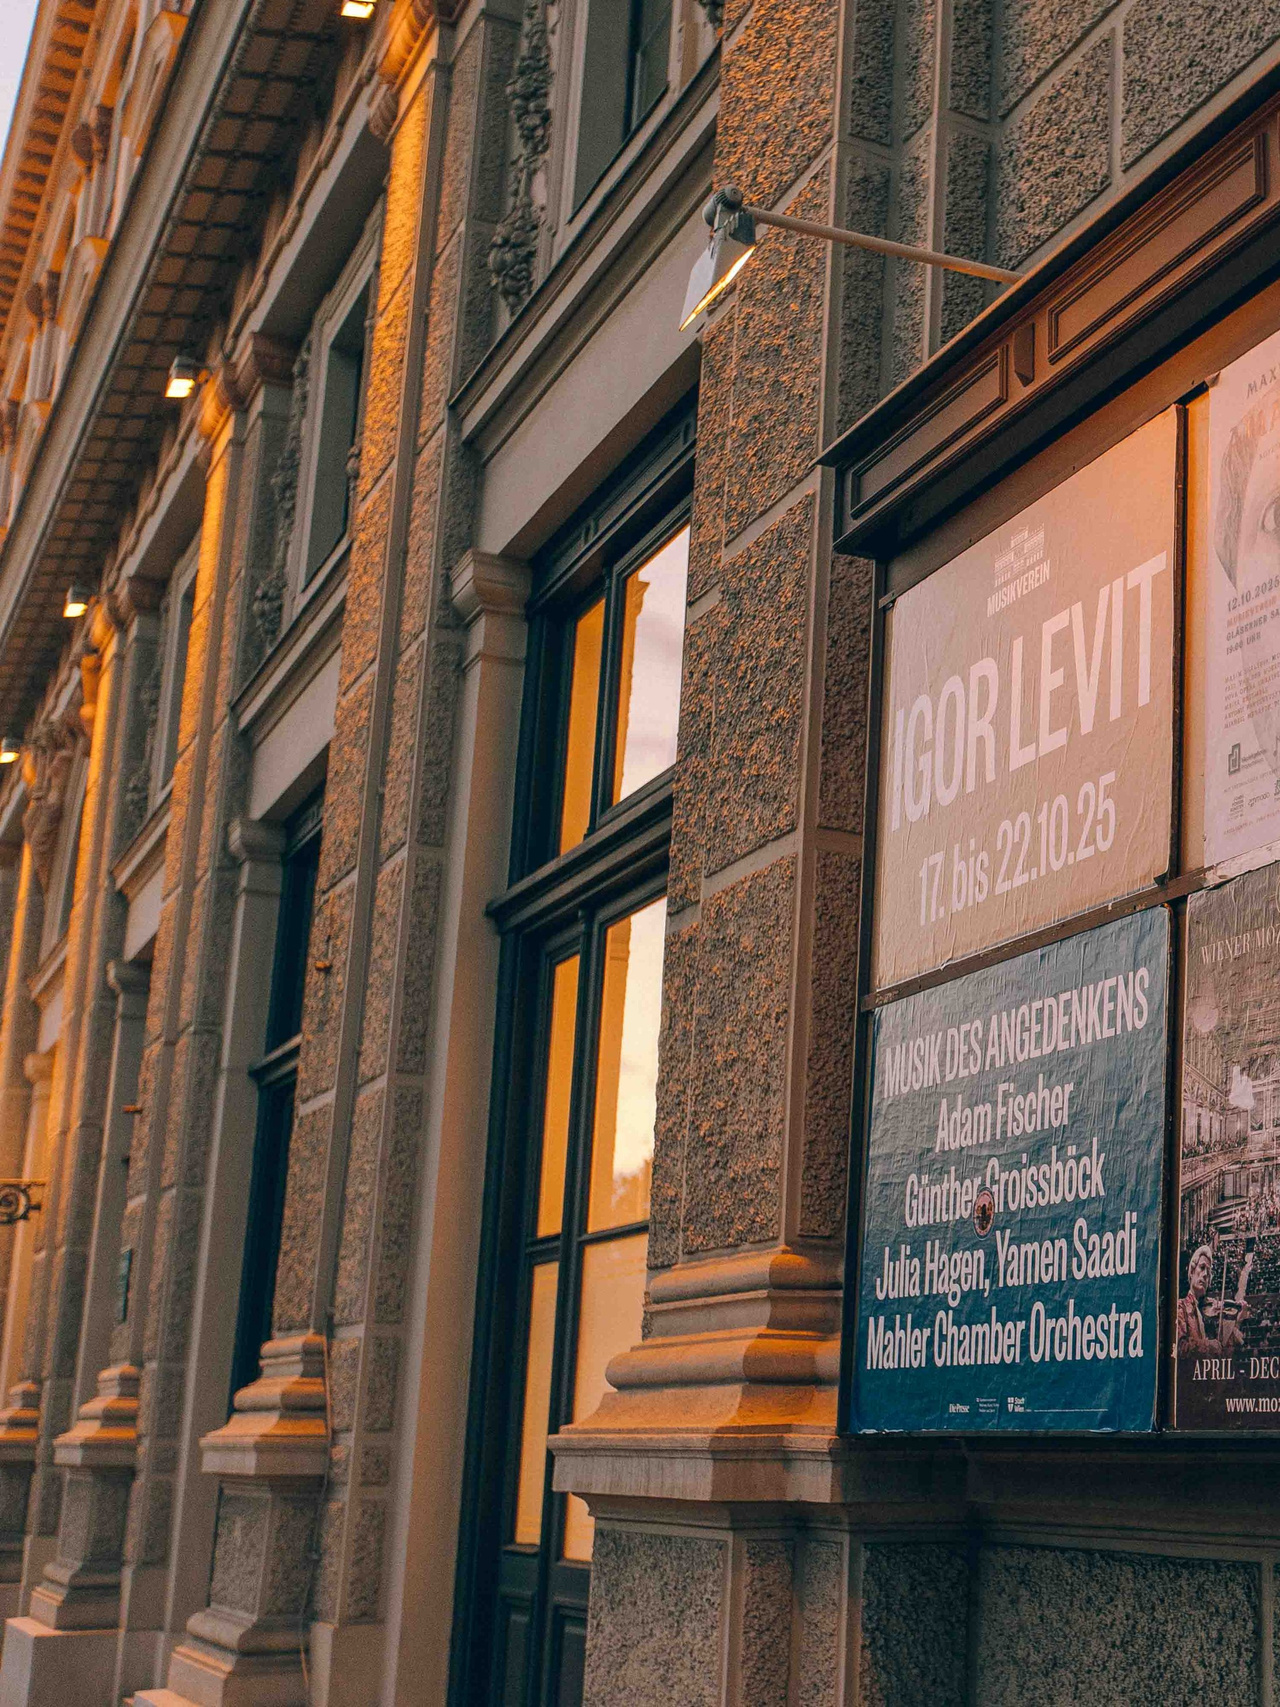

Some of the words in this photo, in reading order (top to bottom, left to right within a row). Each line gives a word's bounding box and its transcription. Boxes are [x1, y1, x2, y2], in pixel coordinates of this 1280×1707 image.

[987, 559, 1051, 617] MUSIKVEREIN
[1227, 575, 1280, 612] 12.10.2025
[891, 656, 999, 832] IGOR
[1009, 550, 1167, 773] LEVIT
[919, 850, 944, 927] 17.
[951, 833, 989, 911] bis
[995, 770, 1116, 894] 22.10.25
[1202, 934, 1250, 965] WIENER
[884, 1031, 942, 1099] MUSIK
[945, 1018, 983, 1082] DES
[984, 966, 1149, 1071] ANGEDENKENS
[935, 1094, 992, 1153] Adam
[996, 1073, 1074, 1140] Fischer
[905, 1164, 981, 1228] Günther
[876, 1243, 920, 1300] Julia
[924, 1239, 990, 1307] Hagen,
[995, 1228, 1067, 1288] Yamen
[1072, 1210, 1137, 1280] Saadi
[866, 1313, 931, 1370] Mahler
[933, 1306, 1026, 1367] Chamber
[1029, 1299, 1144, 1363] Orchestra
[1193, 1358, 1235, 1380] APRIL
